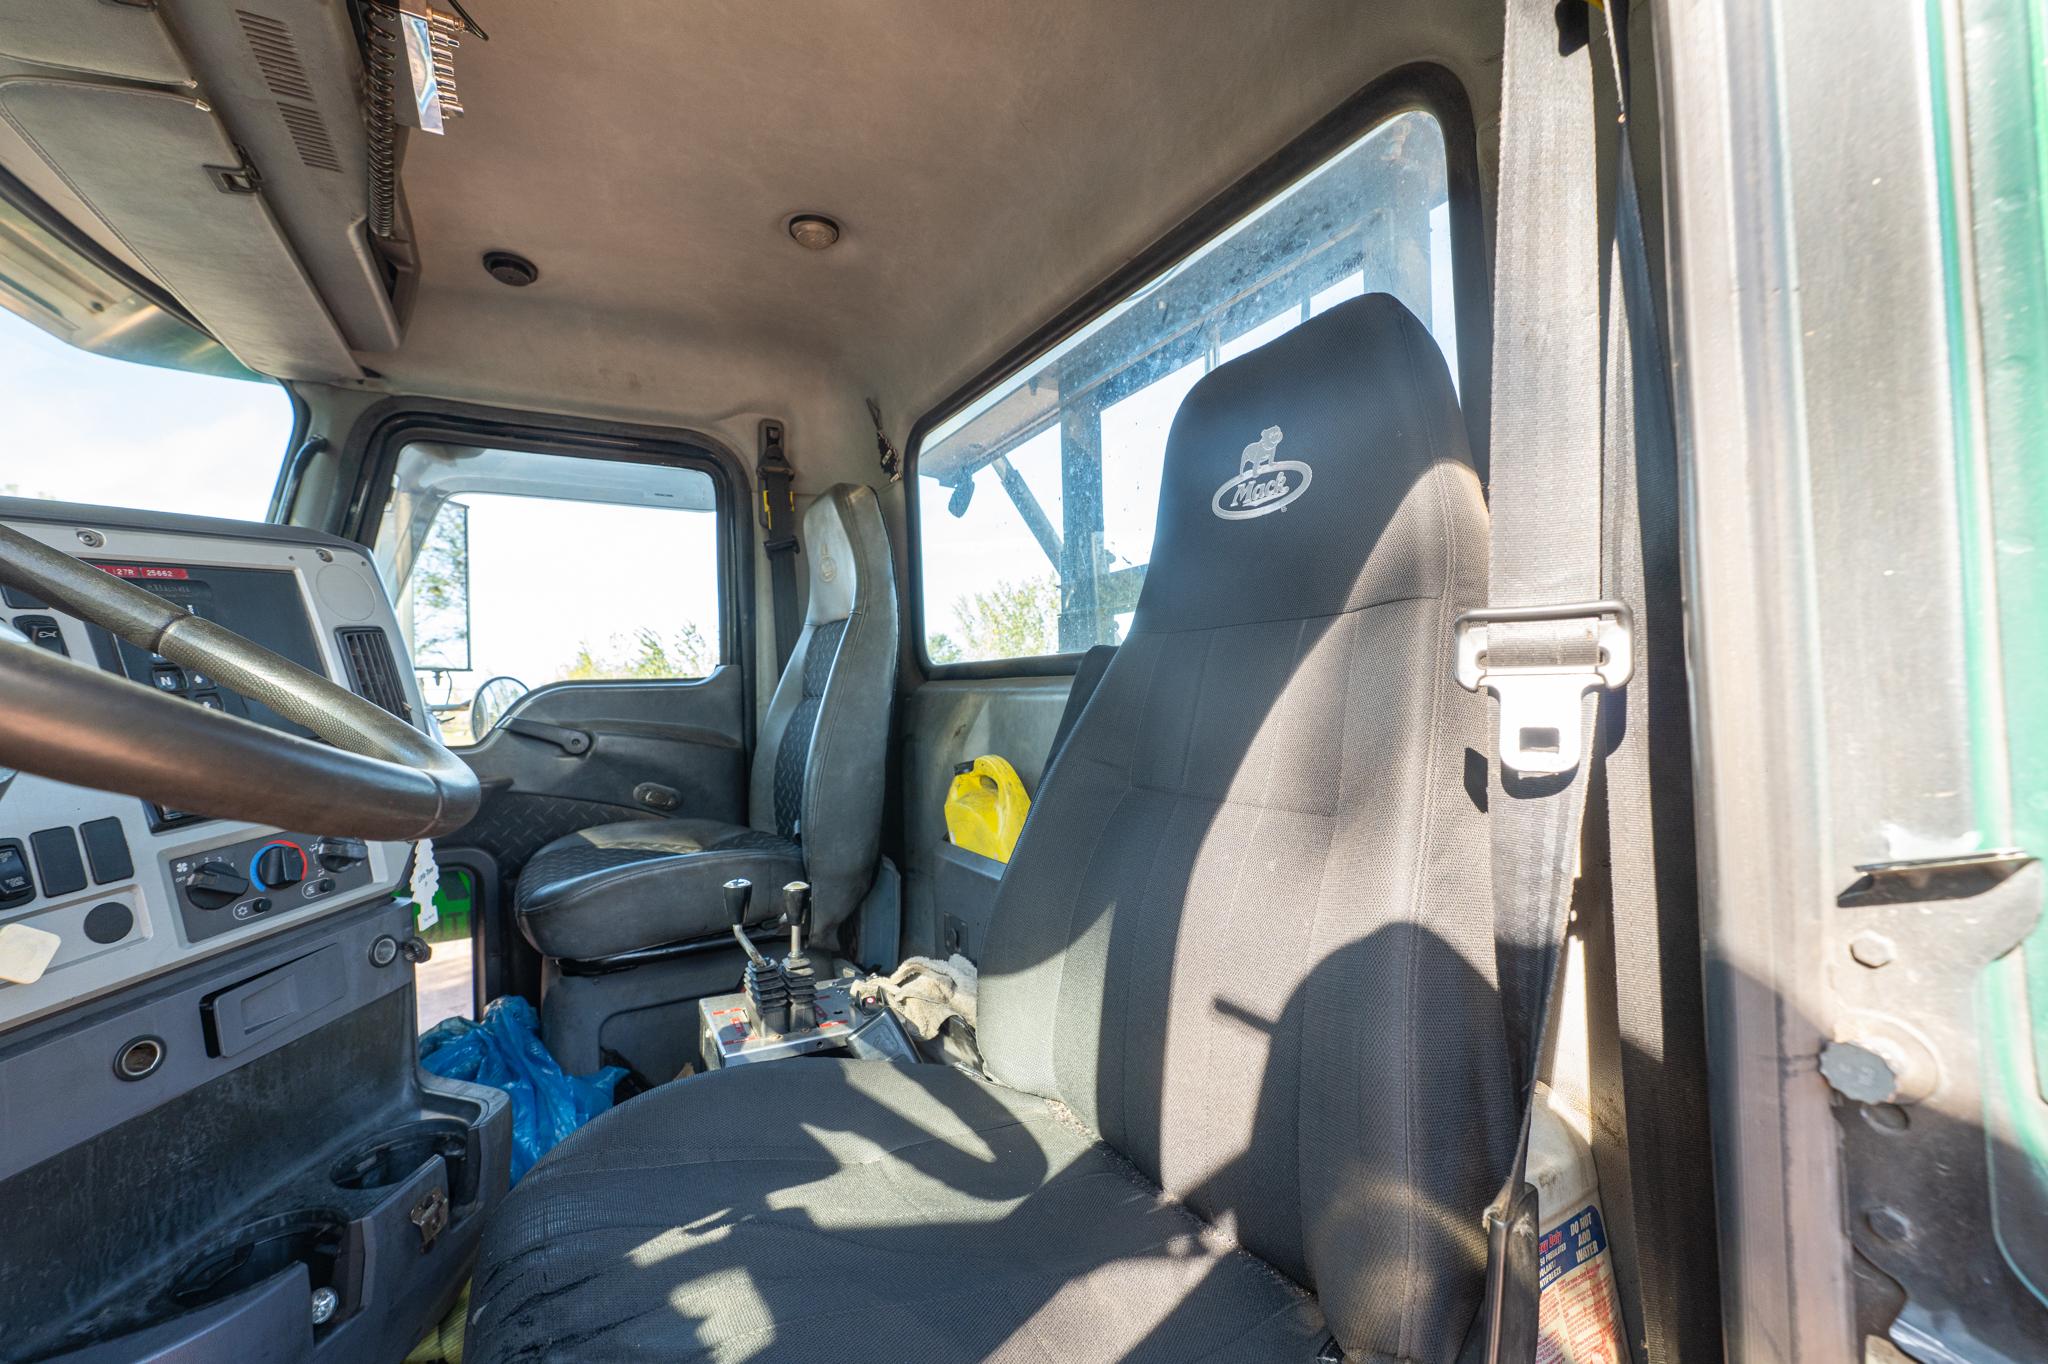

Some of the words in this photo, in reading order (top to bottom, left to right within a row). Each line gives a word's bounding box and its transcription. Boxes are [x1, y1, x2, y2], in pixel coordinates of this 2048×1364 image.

[1230, 471, 1290, 507] Mack
[160, 676, 172, 686] N
[1570, 1220, 1580, 1237] DO
[1579, 1212, 1592, 1231] NOT
[1578, 1228, 1591, 1247] ADD
[1575, 1239, 1599, 1264] WATER
